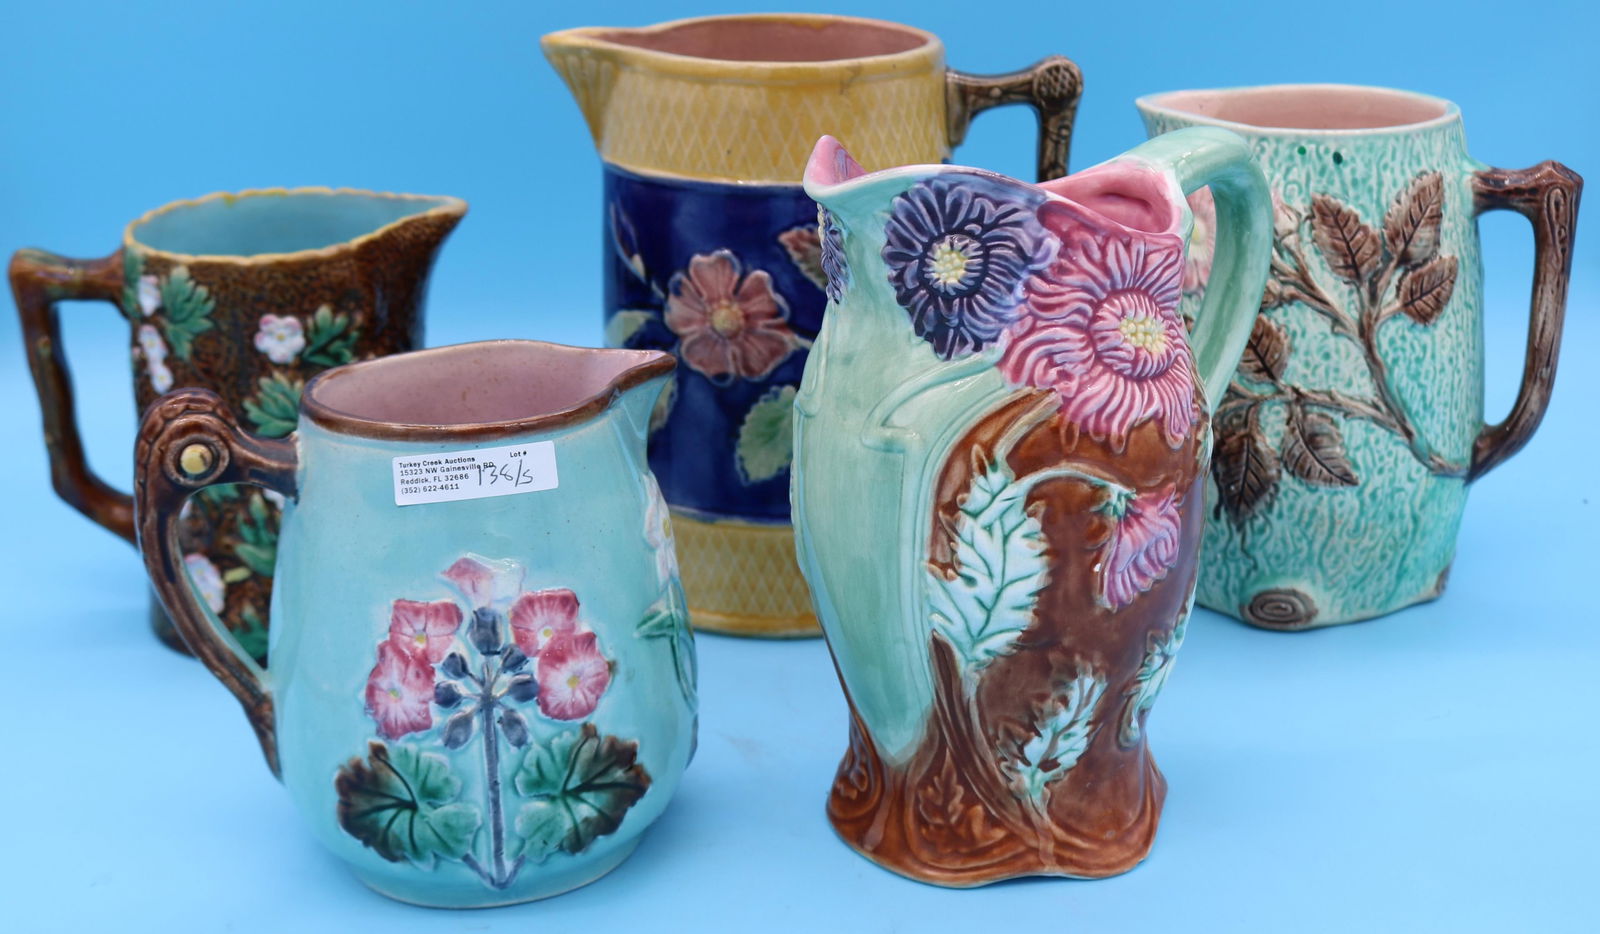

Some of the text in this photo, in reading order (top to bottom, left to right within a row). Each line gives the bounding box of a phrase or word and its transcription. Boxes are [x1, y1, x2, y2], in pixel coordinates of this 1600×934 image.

[400, 468, 423, 476] 15323
[440, 463, 480, 473] Gainesville
[400, 477, 431, 485] Reddick,
[445, 473, 469, 481] 32686
[401, 483, 460, 495] (352) 622-4611
